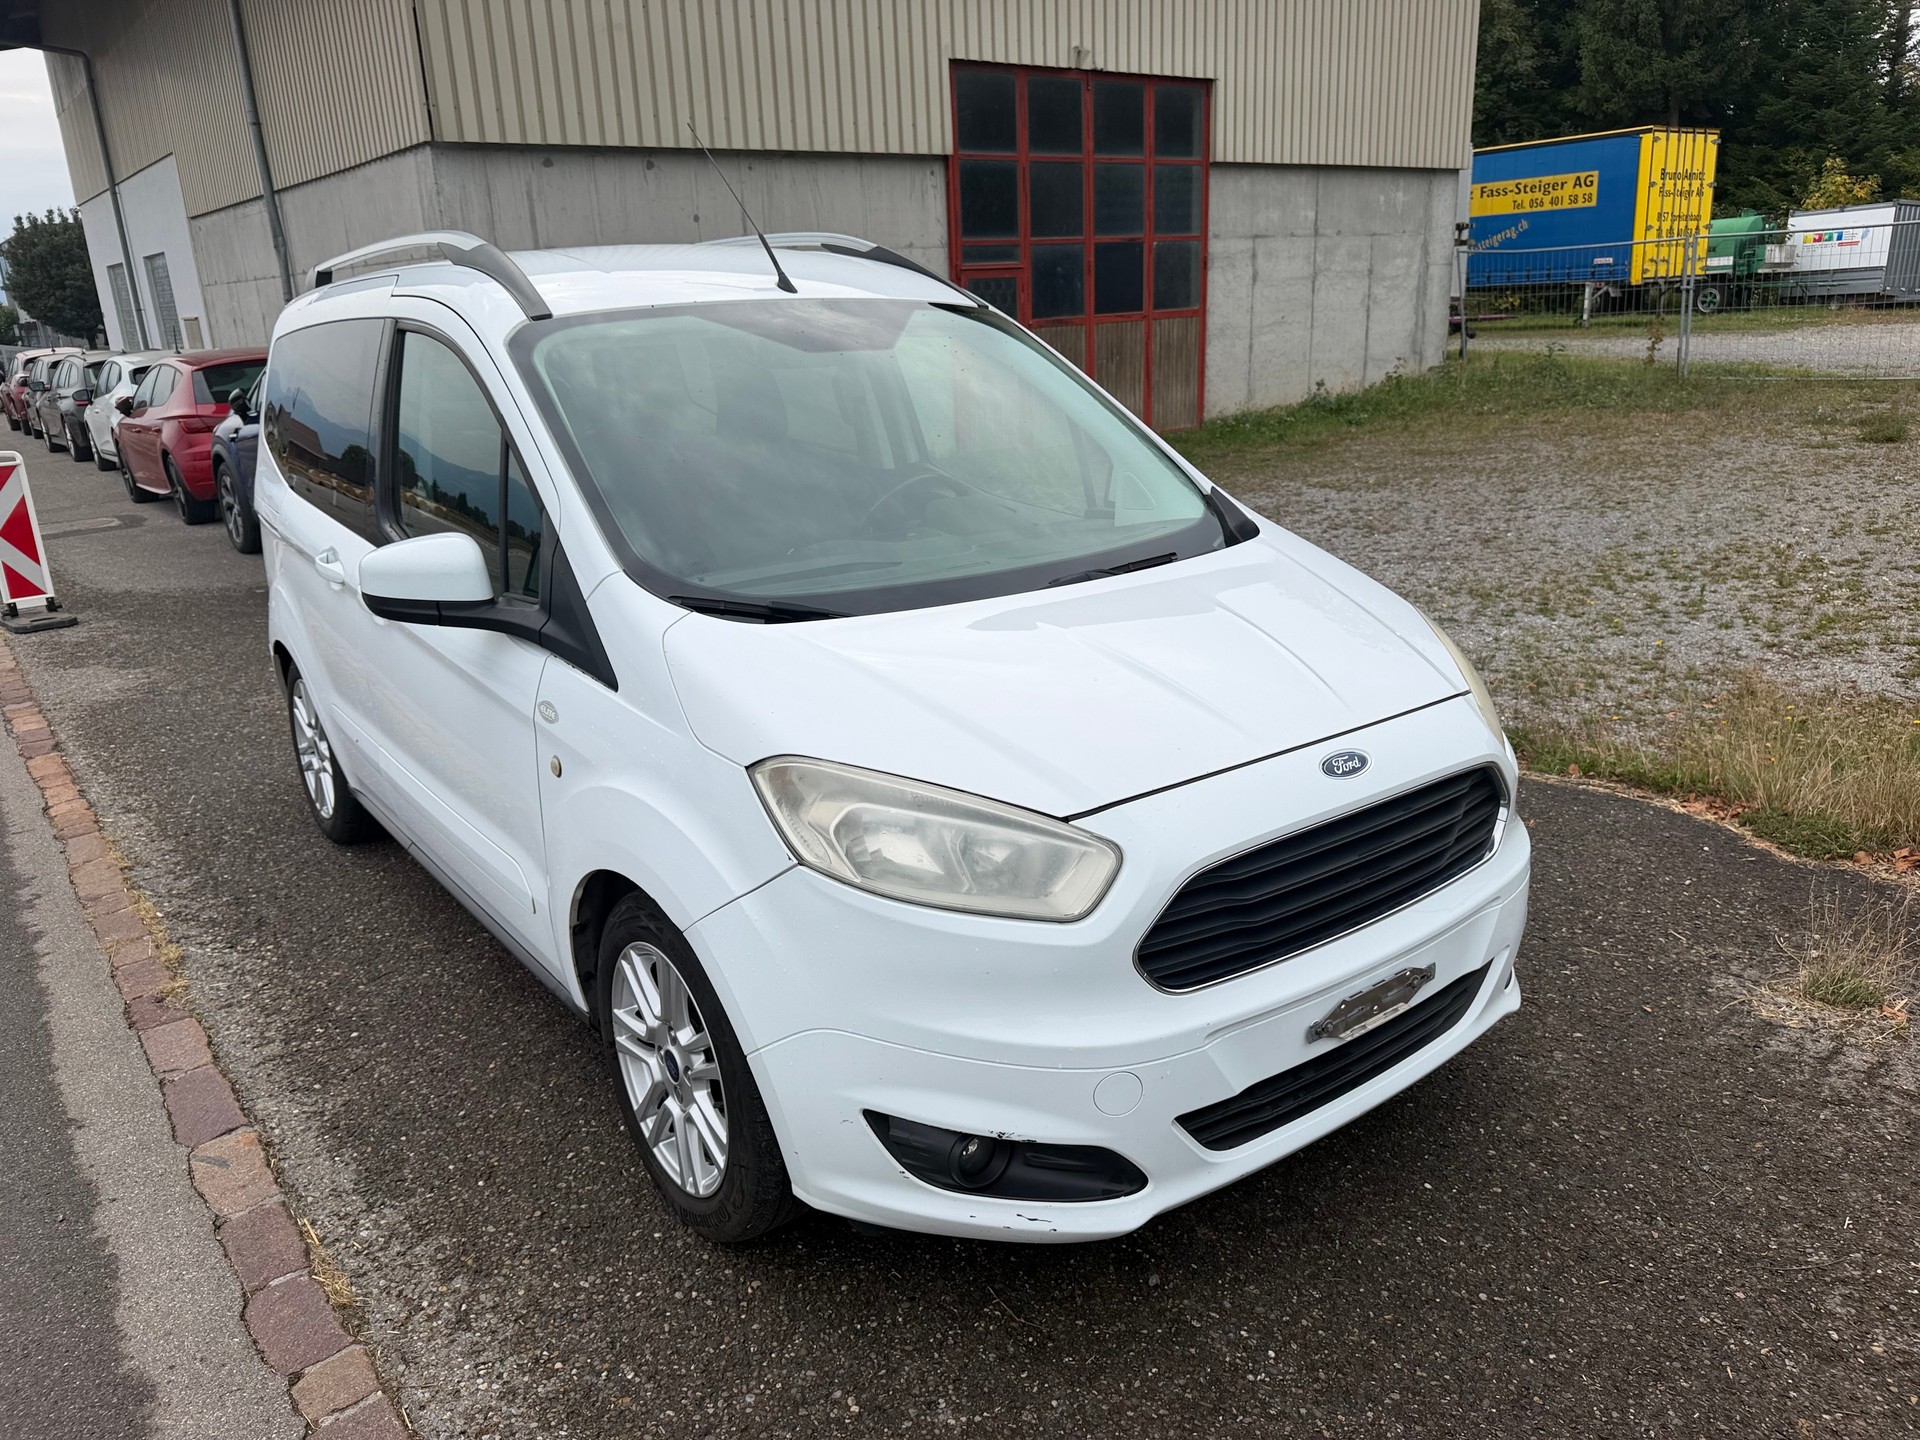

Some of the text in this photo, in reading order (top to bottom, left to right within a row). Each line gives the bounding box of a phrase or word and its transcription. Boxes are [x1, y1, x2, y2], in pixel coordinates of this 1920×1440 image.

[1480, 179, 1568, 199] Fass-Steiger
[1572, 174, 1595, 190] AG
[1512, 192, 1593, 211] Tel. 056 401 58 58
[1332, 755, 1362, 774] Ford
